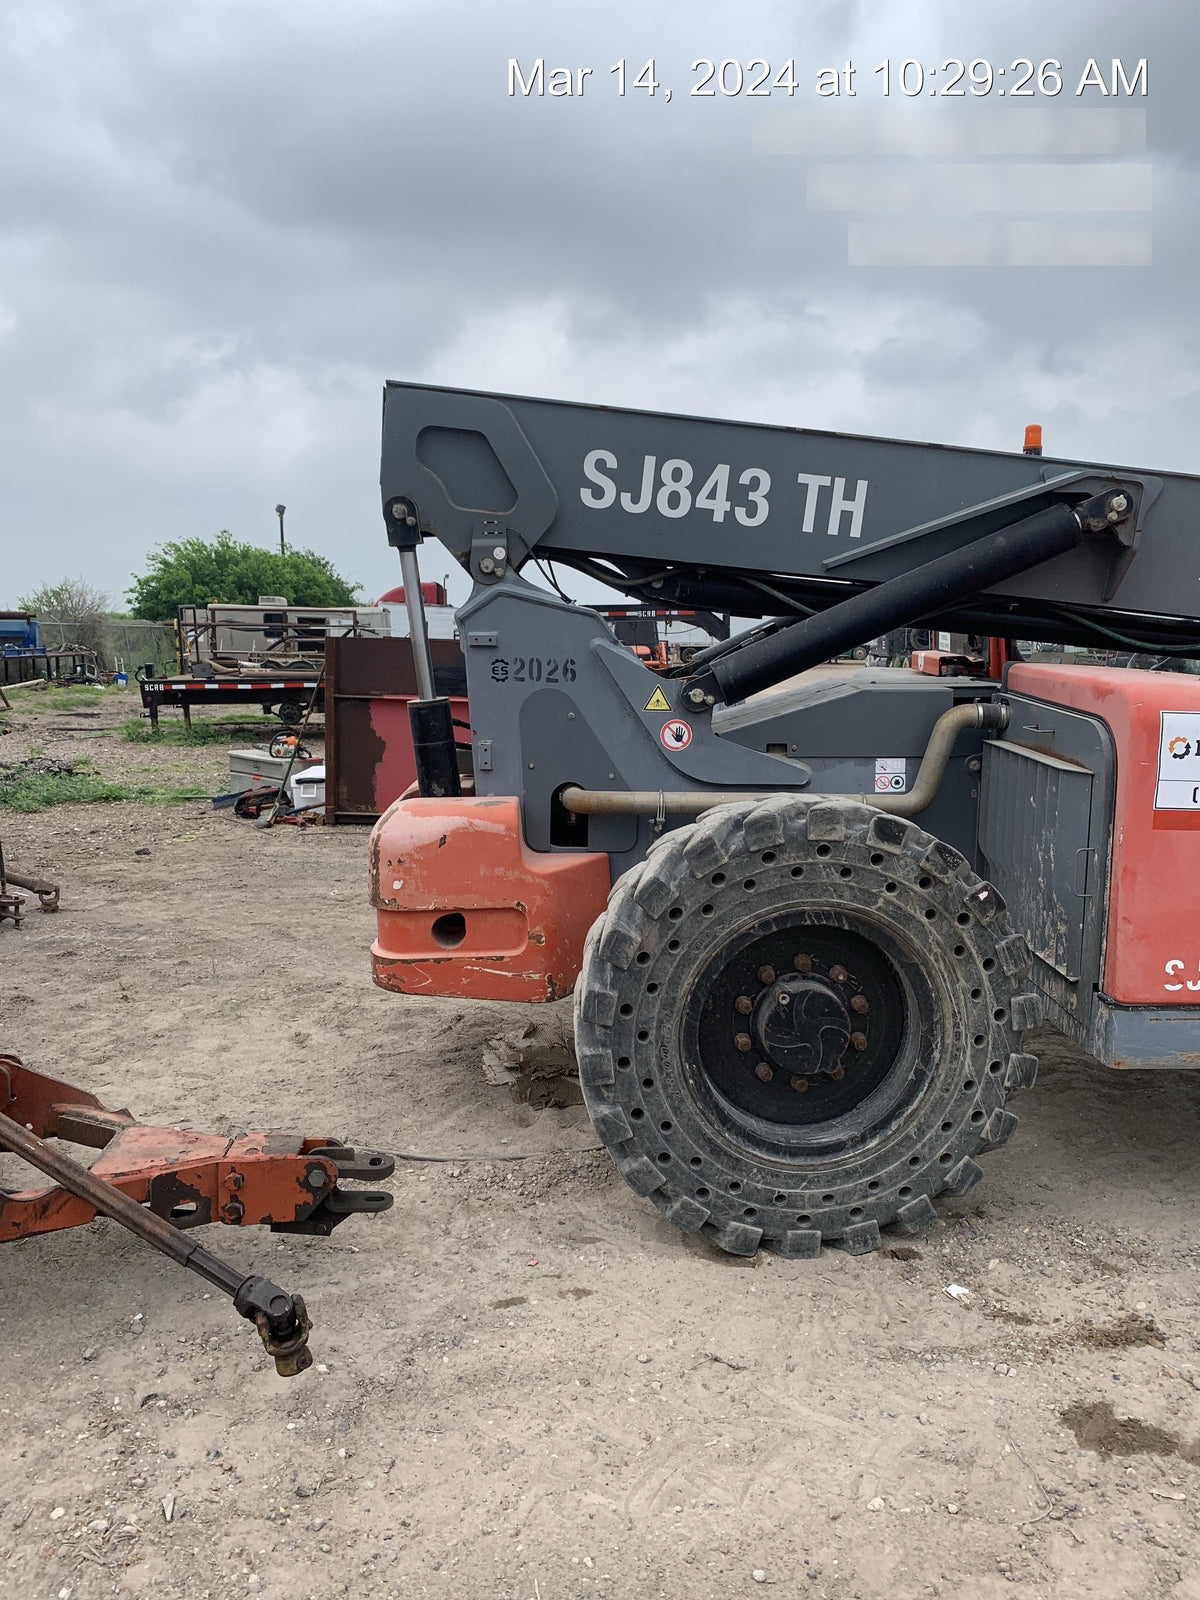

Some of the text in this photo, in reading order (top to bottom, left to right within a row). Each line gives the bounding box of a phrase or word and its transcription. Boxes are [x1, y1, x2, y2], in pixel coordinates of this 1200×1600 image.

[580, 449, 869, 538] SJ843 TH
[513, 657, 577, 684] 2026
